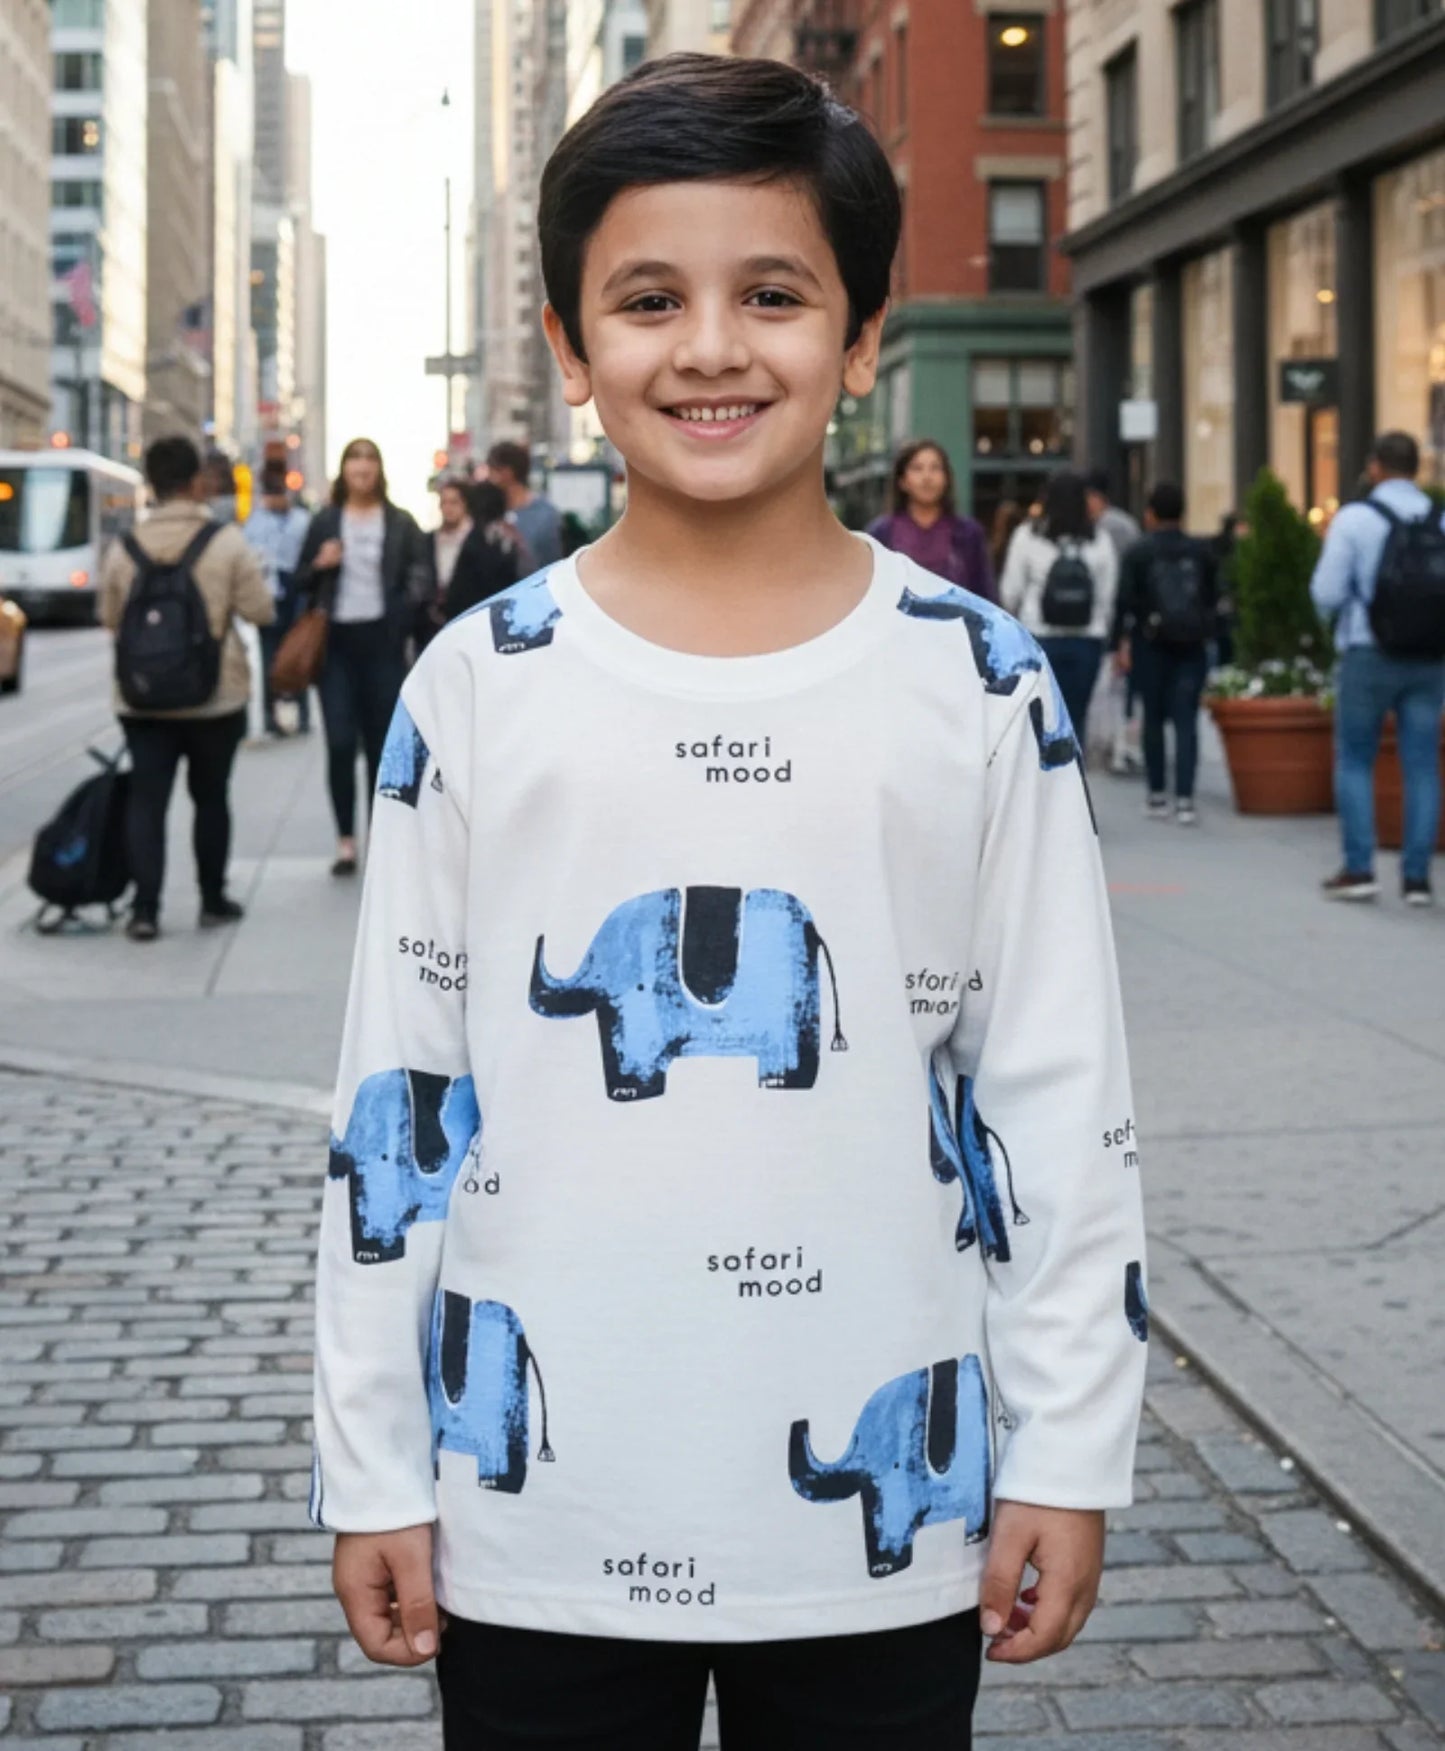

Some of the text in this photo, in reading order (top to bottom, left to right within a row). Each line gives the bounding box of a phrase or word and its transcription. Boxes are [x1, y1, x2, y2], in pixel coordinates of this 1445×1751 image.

[674, 734, 771, 758] safari
[706, 760, 792, 782] mood
[738, 1269, 823, 1297] mood
[629, 1582, 715, 1605] mood
